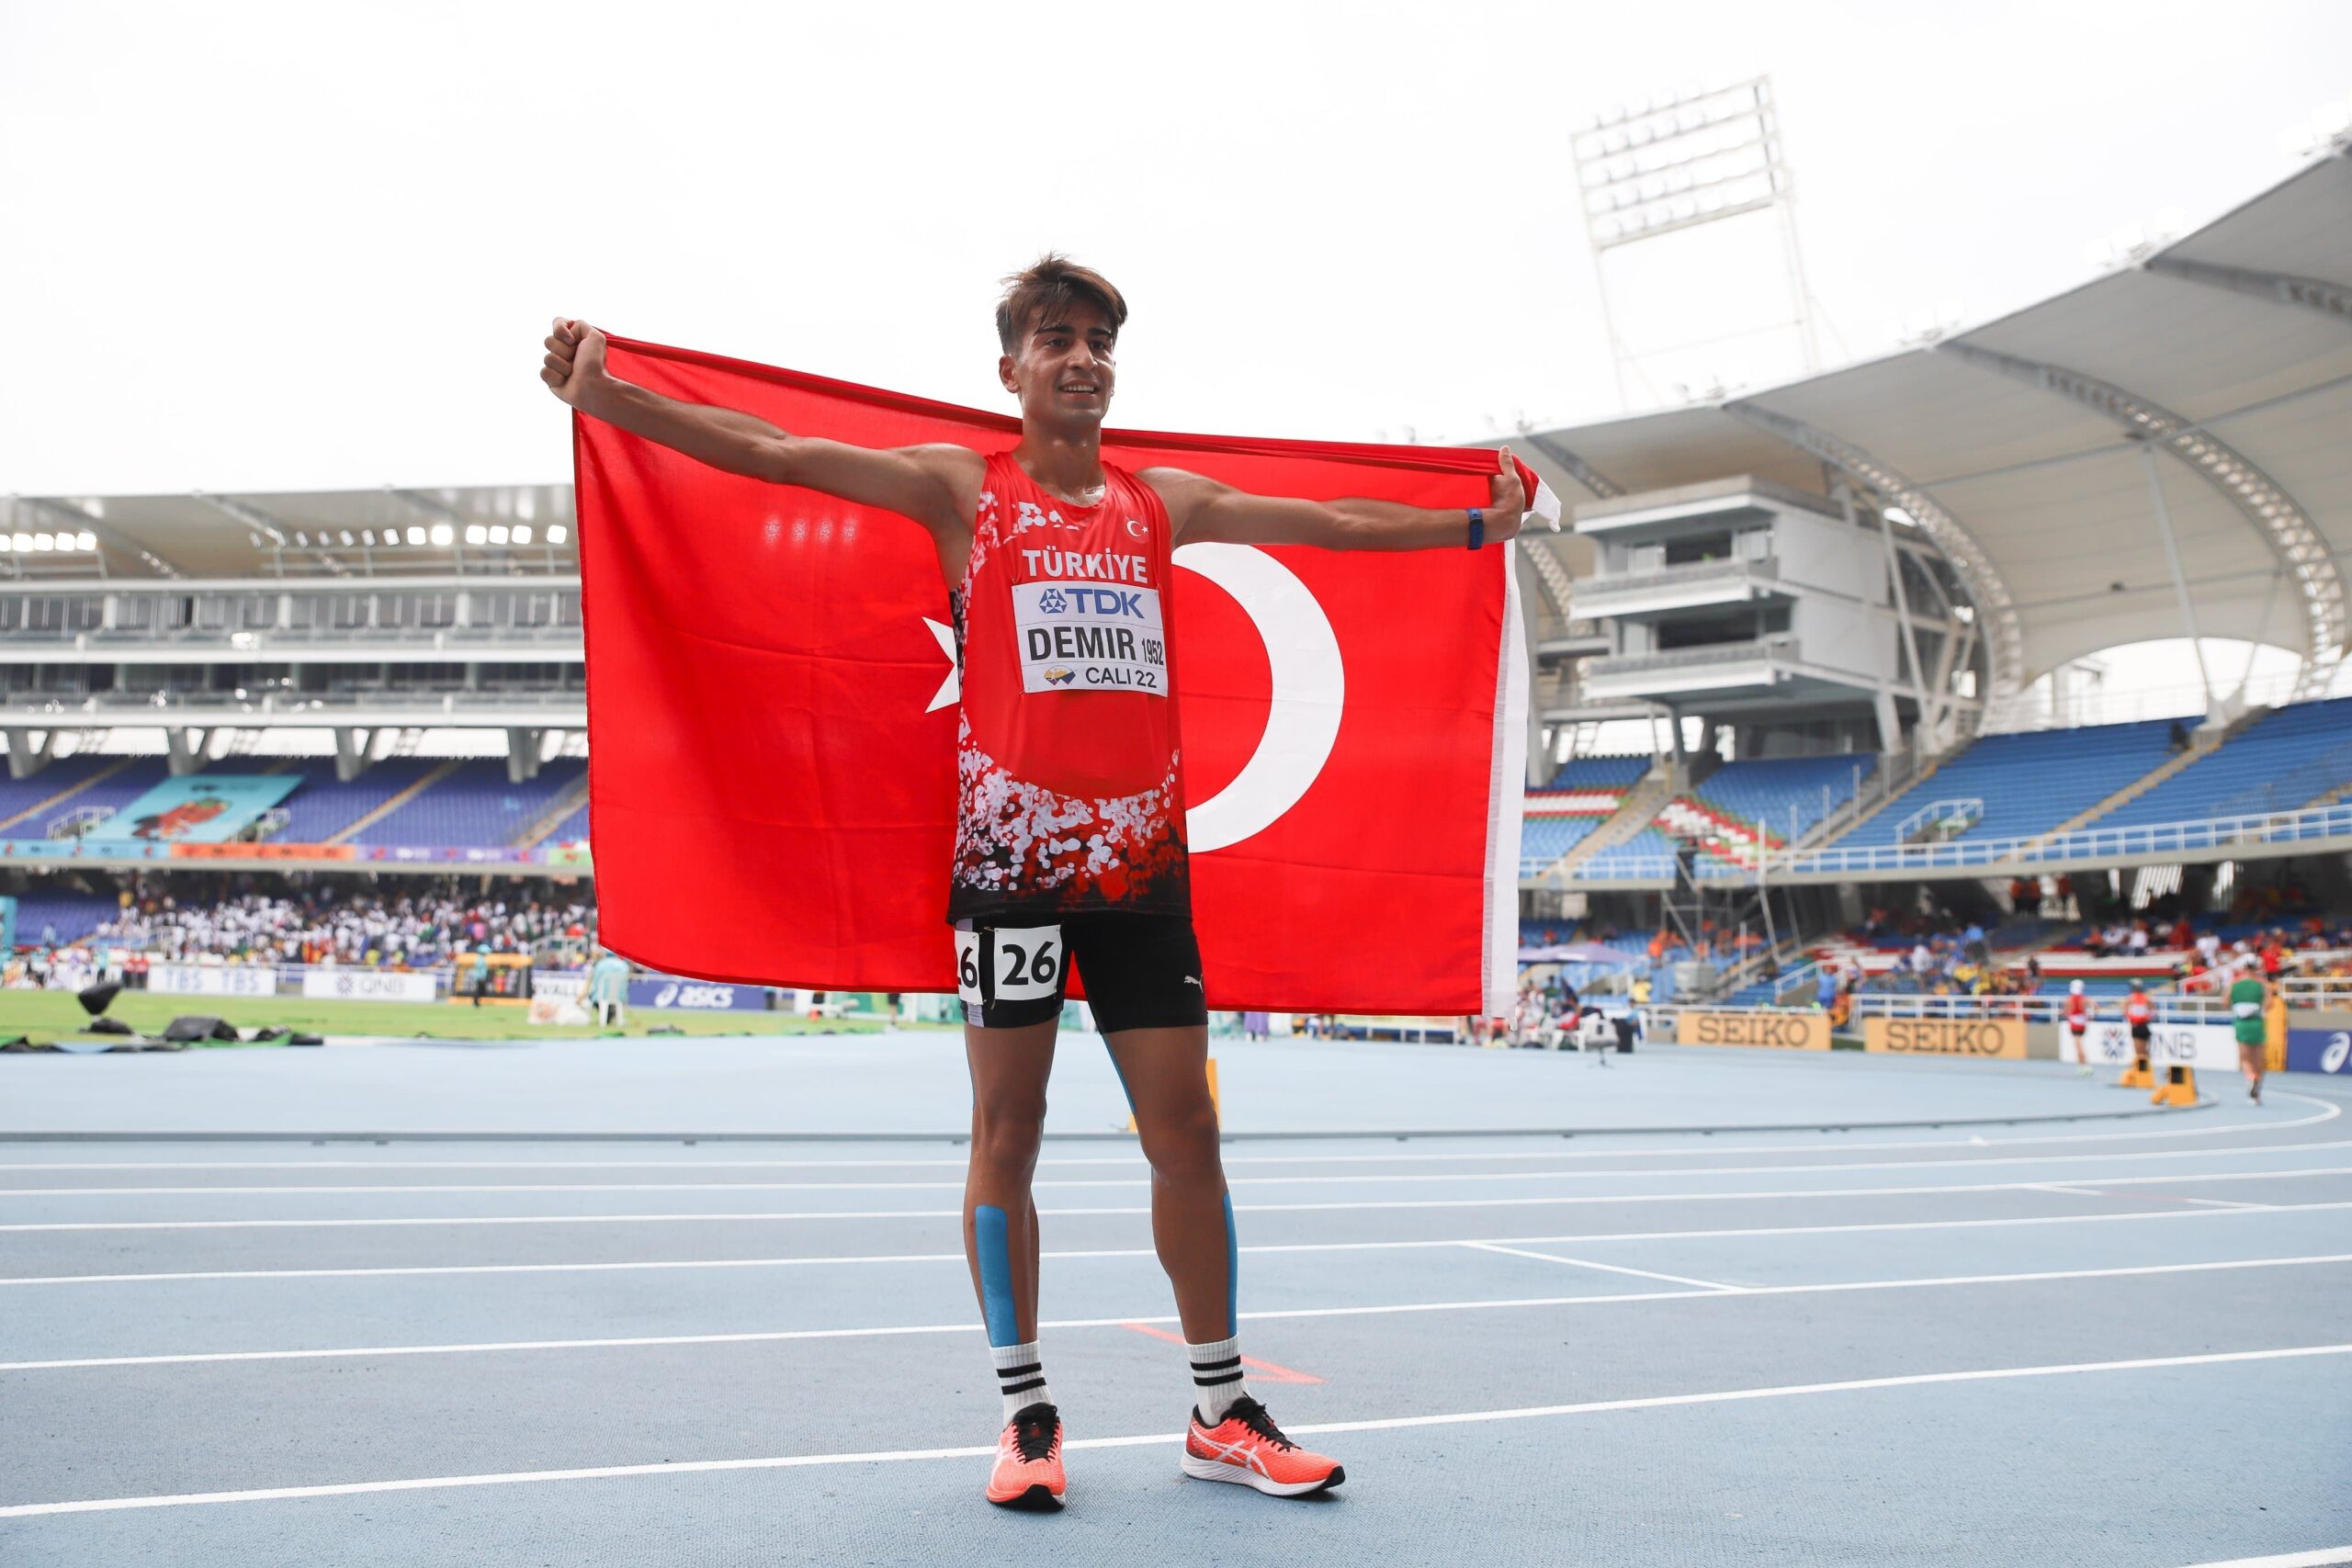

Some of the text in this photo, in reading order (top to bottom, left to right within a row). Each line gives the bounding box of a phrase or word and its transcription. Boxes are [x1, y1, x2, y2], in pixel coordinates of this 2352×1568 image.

[1022, 546, 1148, 583] TÜRKİYE
[1065, 589, 1145, 619] TDK
[1028, 626, 1164, 665] DEMIR 1952
[1085, 667, 1157, 688] CALI 22
[958, 946, 978, 988] 6
[1001, 941, 1057, 986] 26
[1698, 1017, 1810, 1047] SEIKO
[1885, 1021, 2005, 1055] SEIKO
[2150, 1032, 2198, 1059] NB
